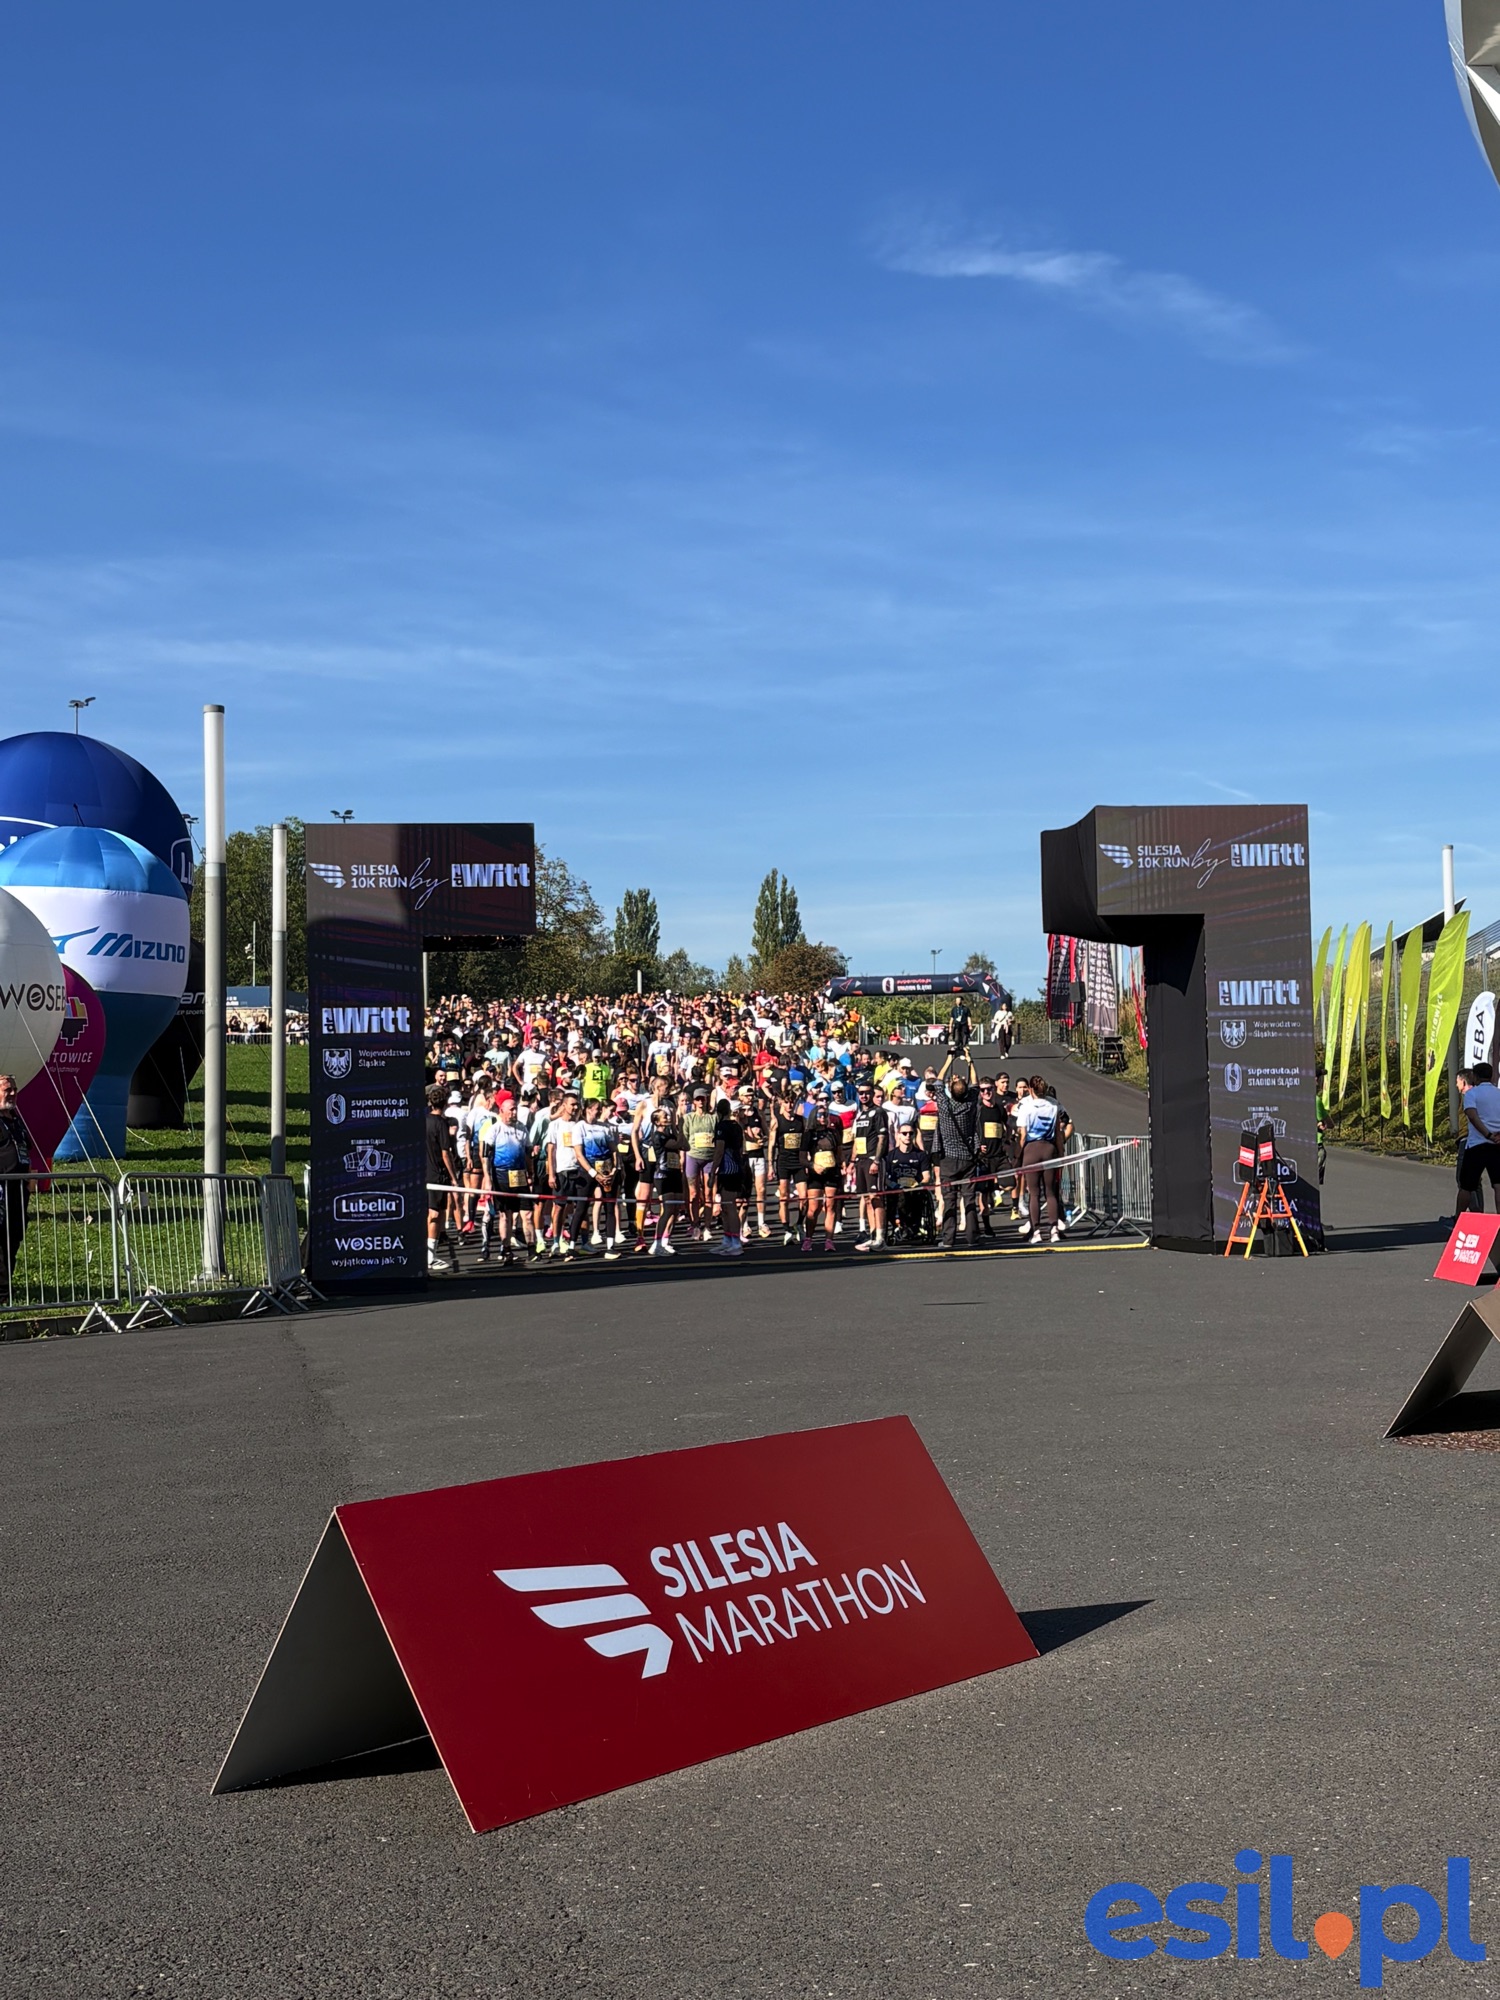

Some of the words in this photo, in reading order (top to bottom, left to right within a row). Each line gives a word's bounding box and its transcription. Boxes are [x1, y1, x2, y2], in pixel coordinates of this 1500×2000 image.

[1137, 845, 1182, 856] SILESIA
[1240, 843, 1305, 867] Witt
[350, 864, 399, 876] SILESIA
[1138, 857, 1162, 868] 10K
[1163, 857, 1190, 868] RUN
[1191, 838, 1228, 889] by
[351, 877, 376, 888] 10K
[379, 877, 408, 888] RUN
[409, 857, 449, 911] by
[462, 863, 530, 887] Witt
[87, 932, 186, 964] MIZUNO
[1229, 980, 1300, 1006] Witt
[333, 1007, 411, 1034] Witt
[1472, 1010, 1485, 1067] EBA
[1247, 1067, 1300, 1076] superauto.pl
[351, 1098, 409, 1107] superauto.pl
[351, 1109, 383, 1119] STADION
[341, 1198, 397, 1213] Lubella
[334, 1236, 404, 1250] WOSEBA
[332, 1258, 379, 1268] wyjątkowa
[381, 1256, 395, 1265] jak
[397, 1255, 408, 1265] Ty
[650, 1521, 818, 1598] SILESIA
[675, 1559, 927, 1664] MARATHON
